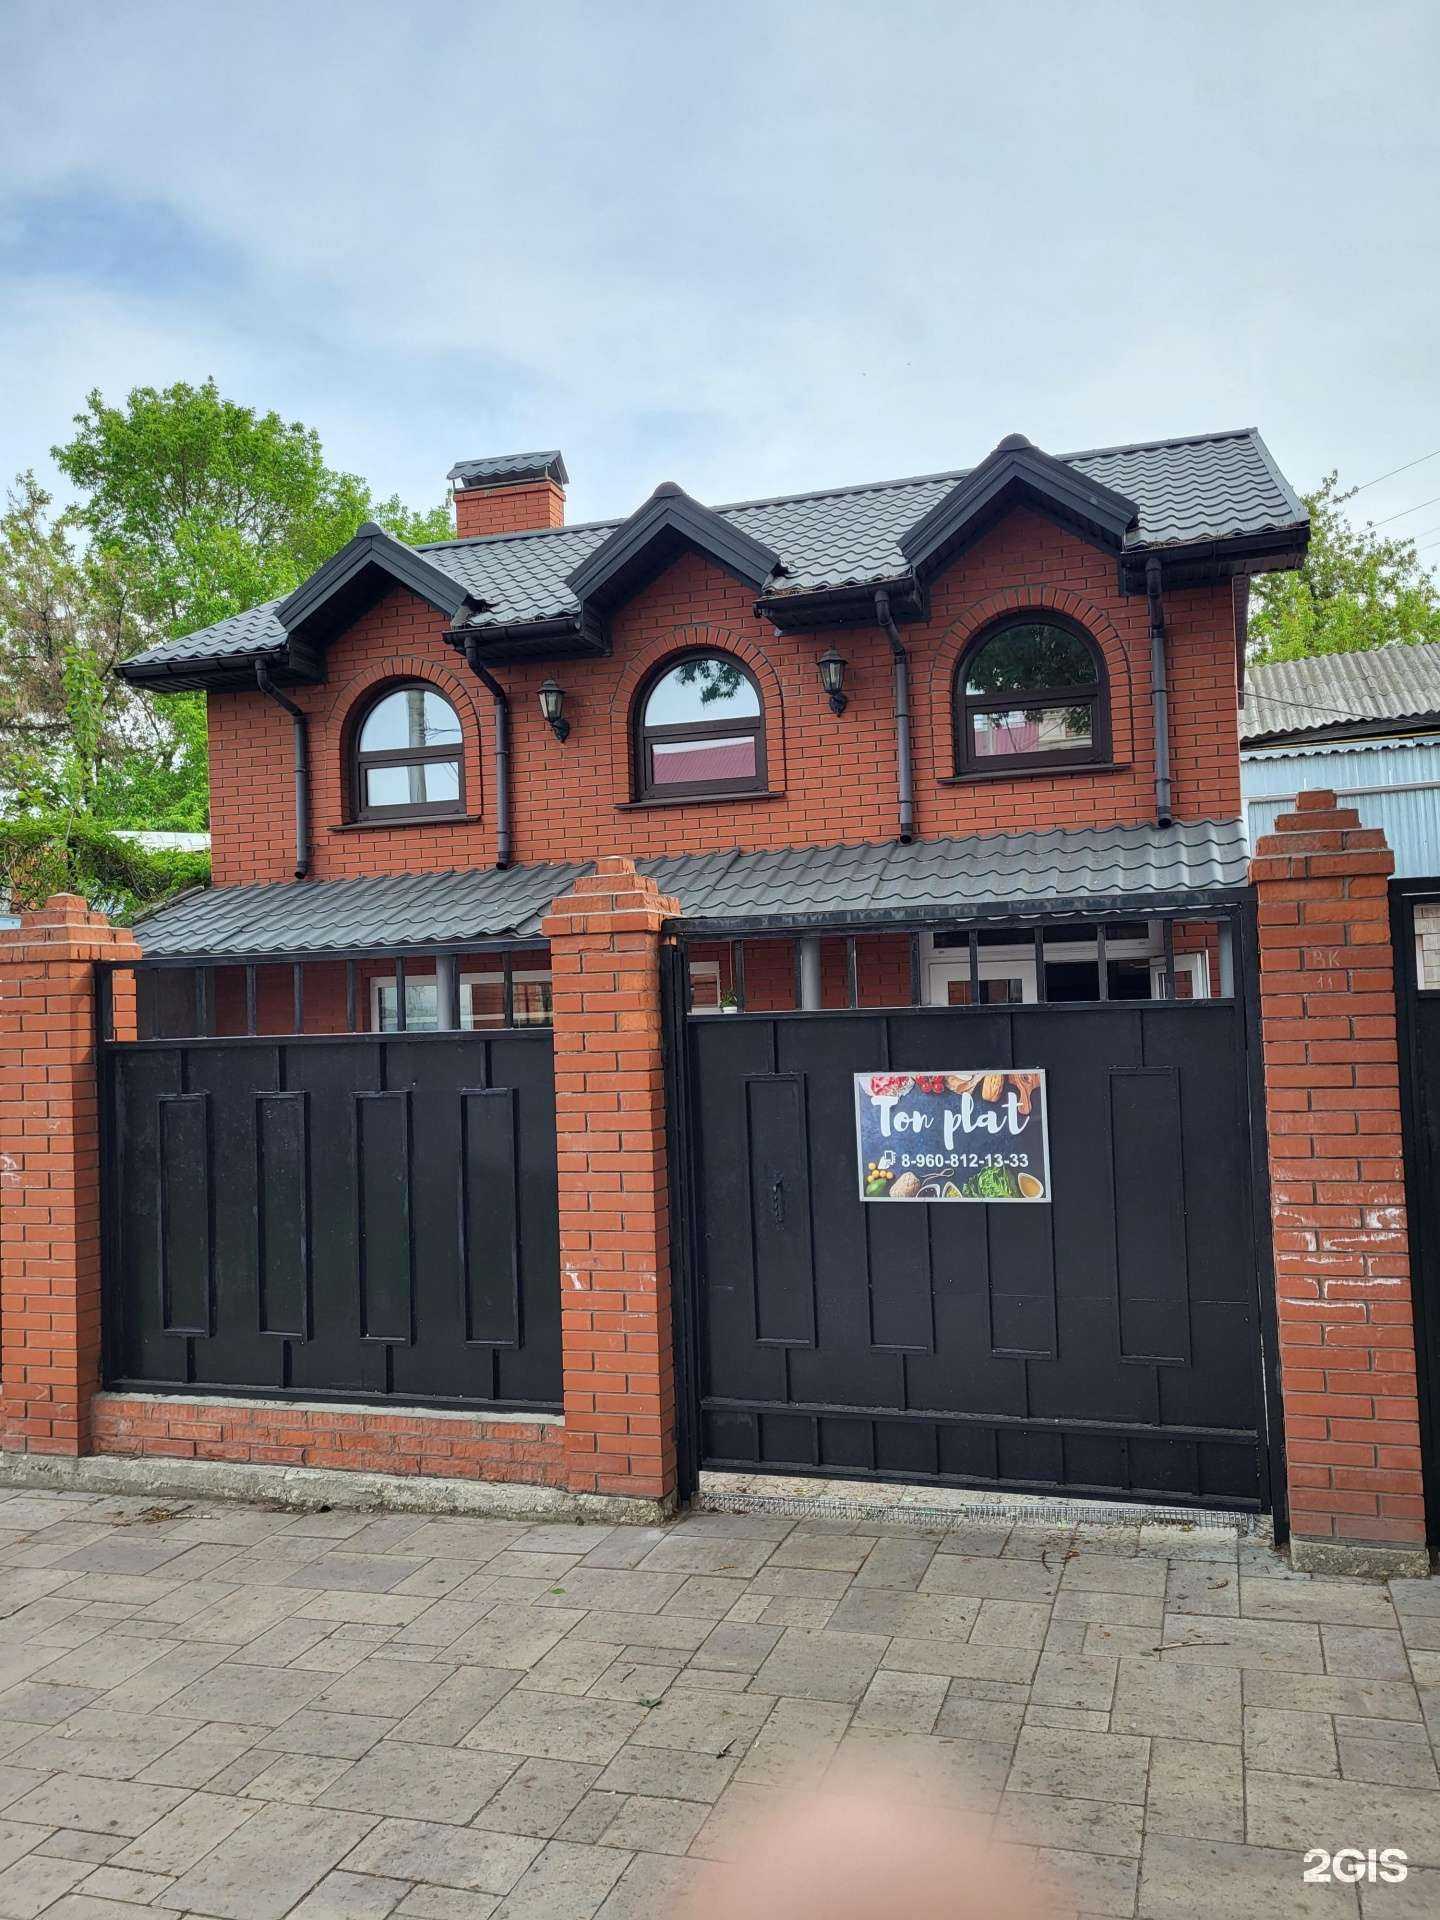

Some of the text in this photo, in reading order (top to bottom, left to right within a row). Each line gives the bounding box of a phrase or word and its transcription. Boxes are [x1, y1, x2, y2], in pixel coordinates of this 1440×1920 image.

[870, 1092, 1030, 1150] Ton plat
[901, 1153, 1029, 1167] 8-960-812-13-33
